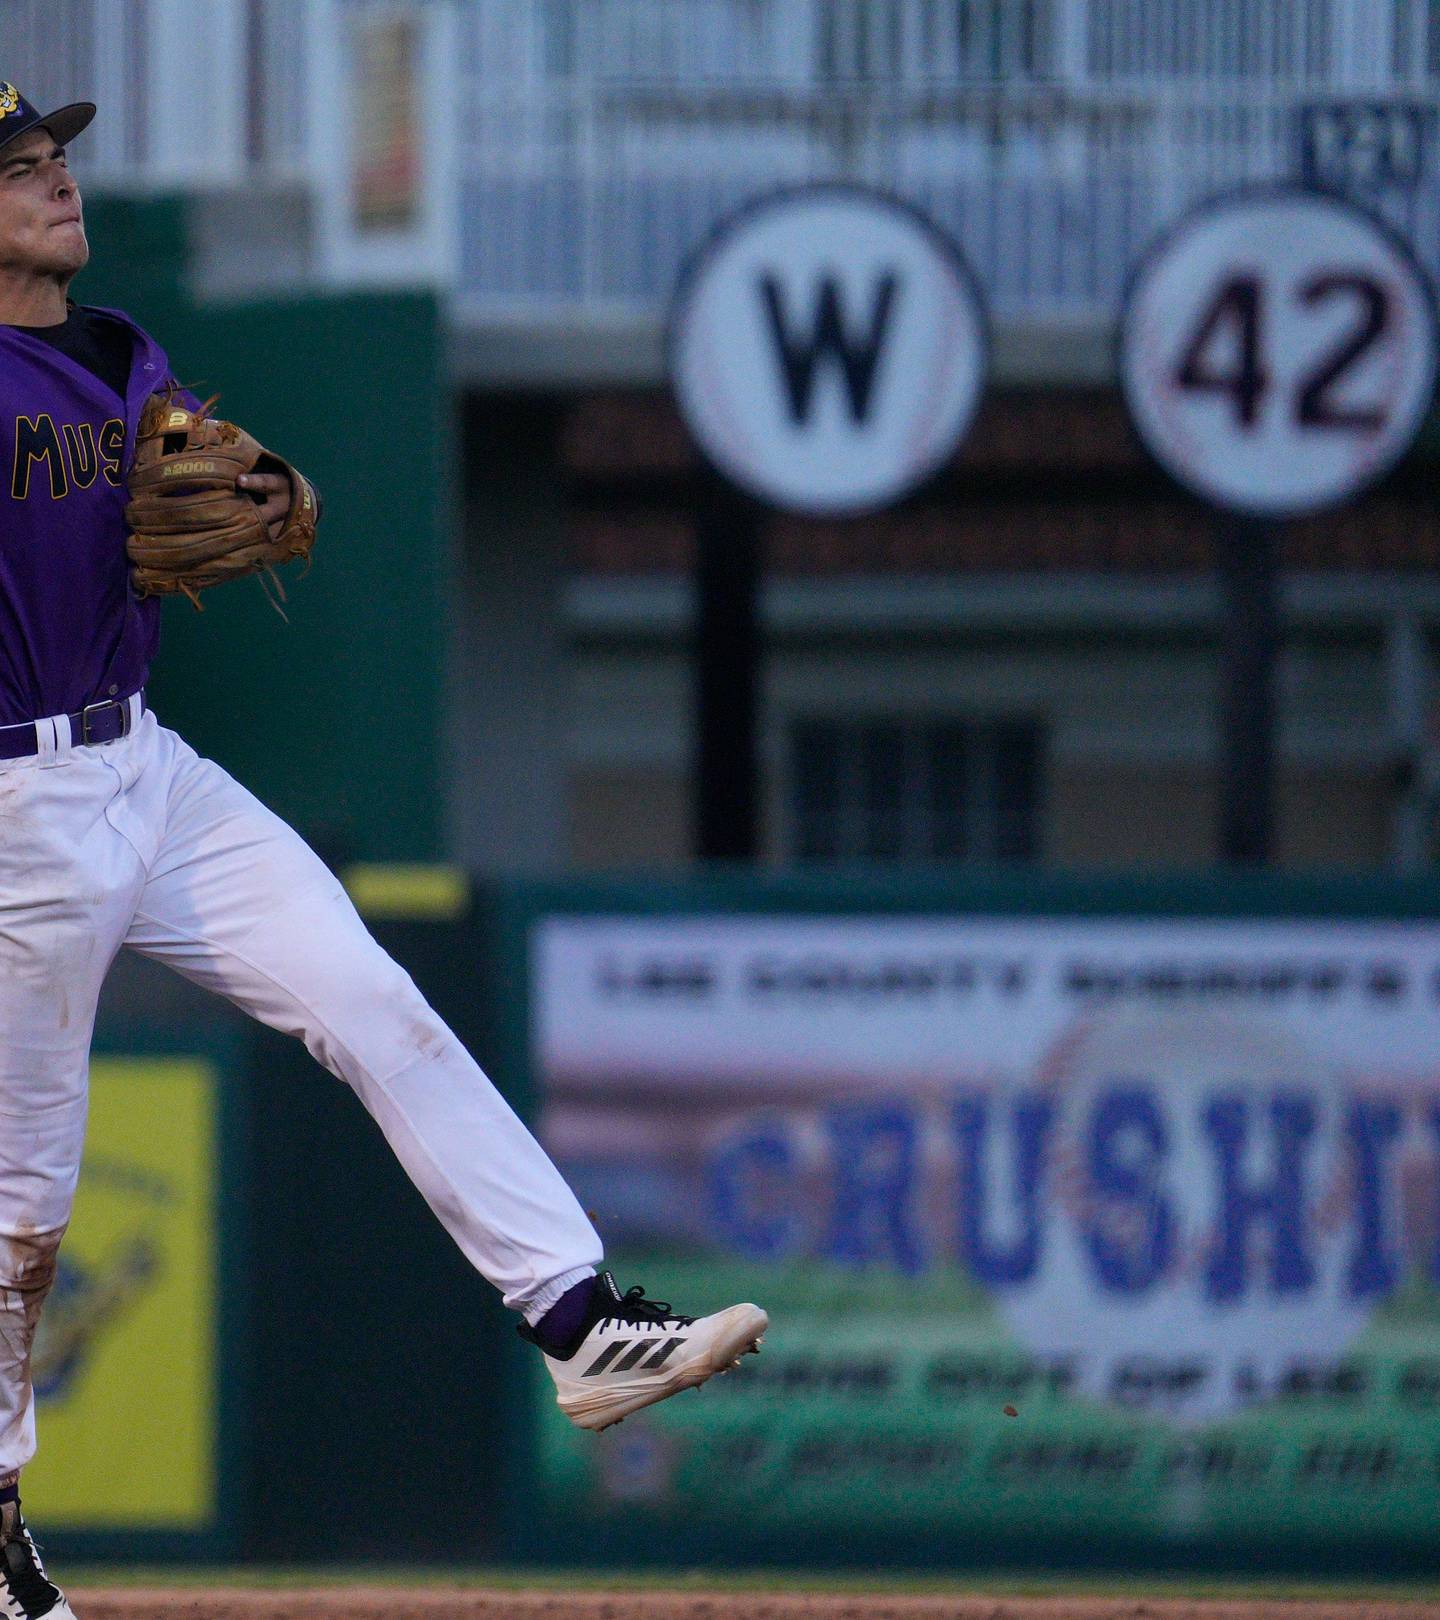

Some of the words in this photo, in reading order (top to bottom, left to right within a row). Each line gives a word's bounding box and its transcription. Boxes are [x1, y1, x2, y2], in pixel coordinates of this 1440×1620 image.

[757, 272, 898, 427] W
[1174, 274, 1388, 429] 42
[597, 958, 715, 995] LEE
[748, 957, 1027, 996] COUNTY
[1063, 958, 1406, 998] SHERIFF'S
[705, 1084, 1440, 1302] CRUSHI
[1110, 1352, 1205, 1391] OF
